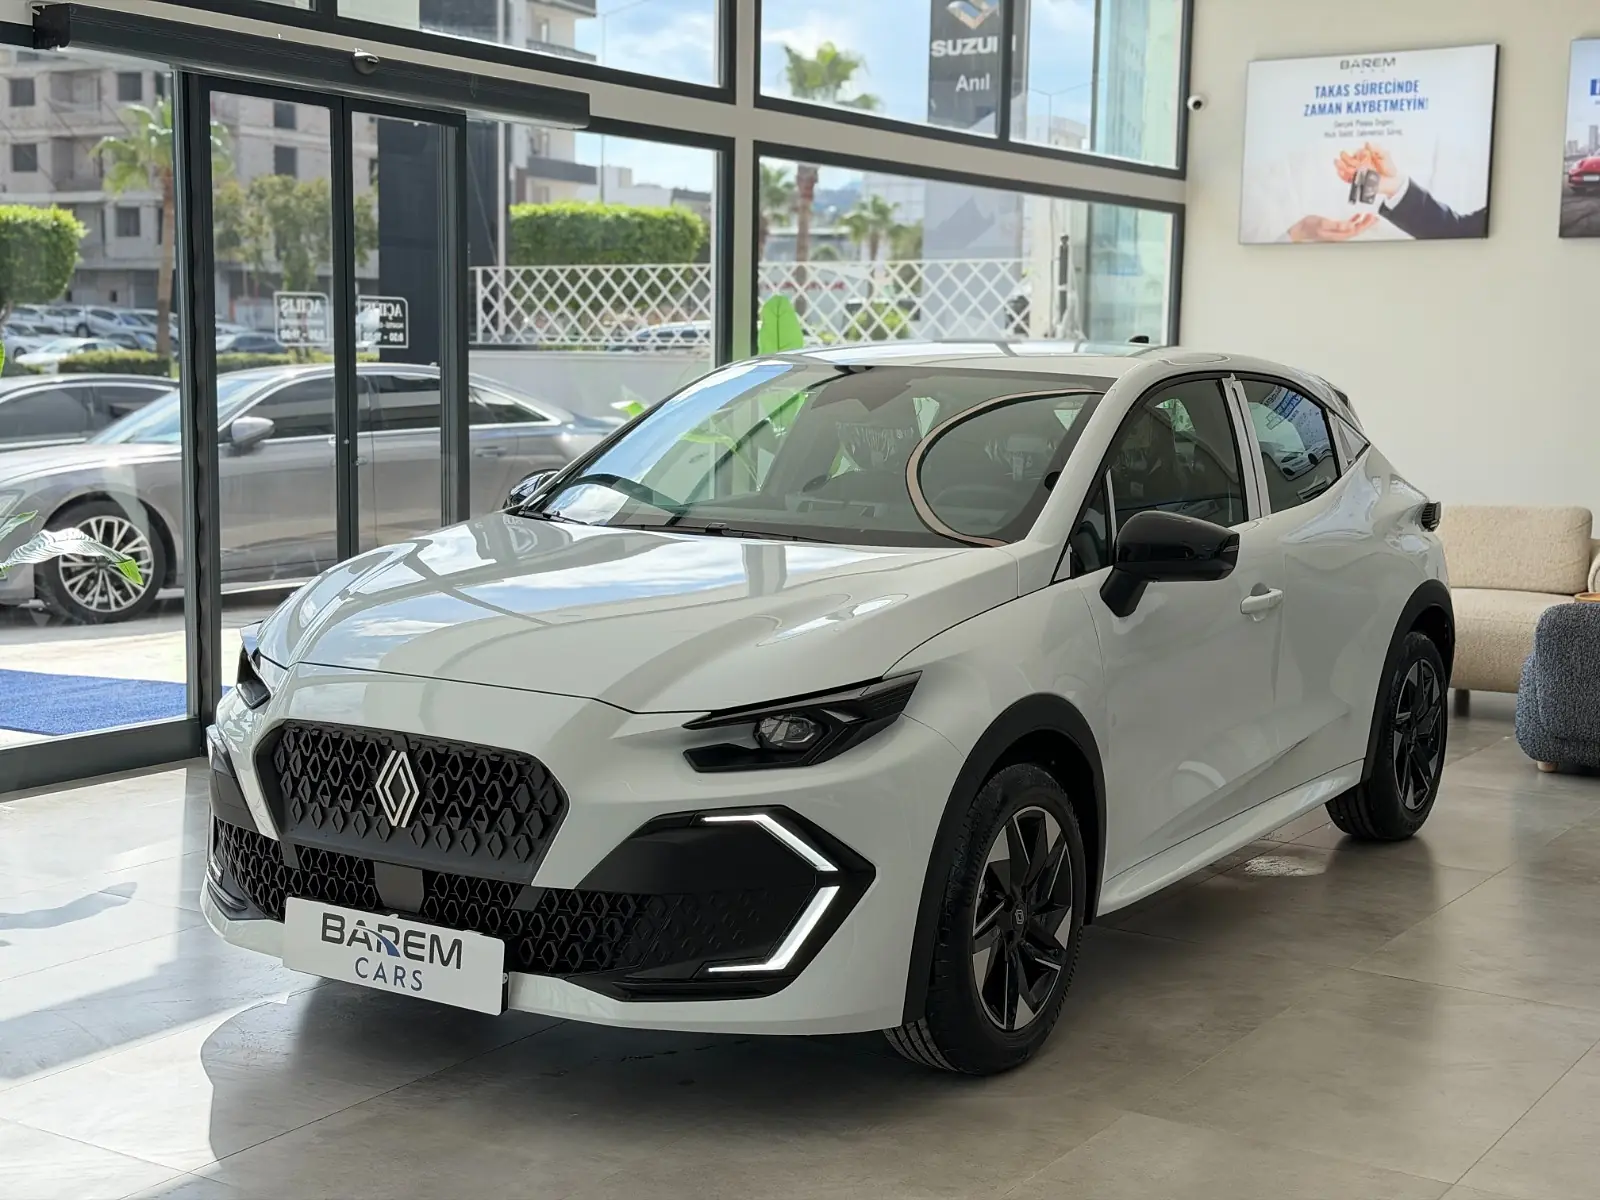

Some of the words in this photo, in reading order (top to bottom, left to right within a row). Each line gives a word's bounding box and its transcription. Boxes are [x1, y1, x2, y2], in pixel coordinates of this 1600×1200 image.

[1339, 56, 1397, 70] BAREM
[955, 72, 991, 92] Anıl
[1315, 83, 1351, 98] TAKAS
[1353, 78, 1421, 96] SÜRECİNDE
[1303, 102, 1343, 117] ZAMAN
[321, 912, 463, 970] BAREM
[354, 956, 424, 992] CARS
